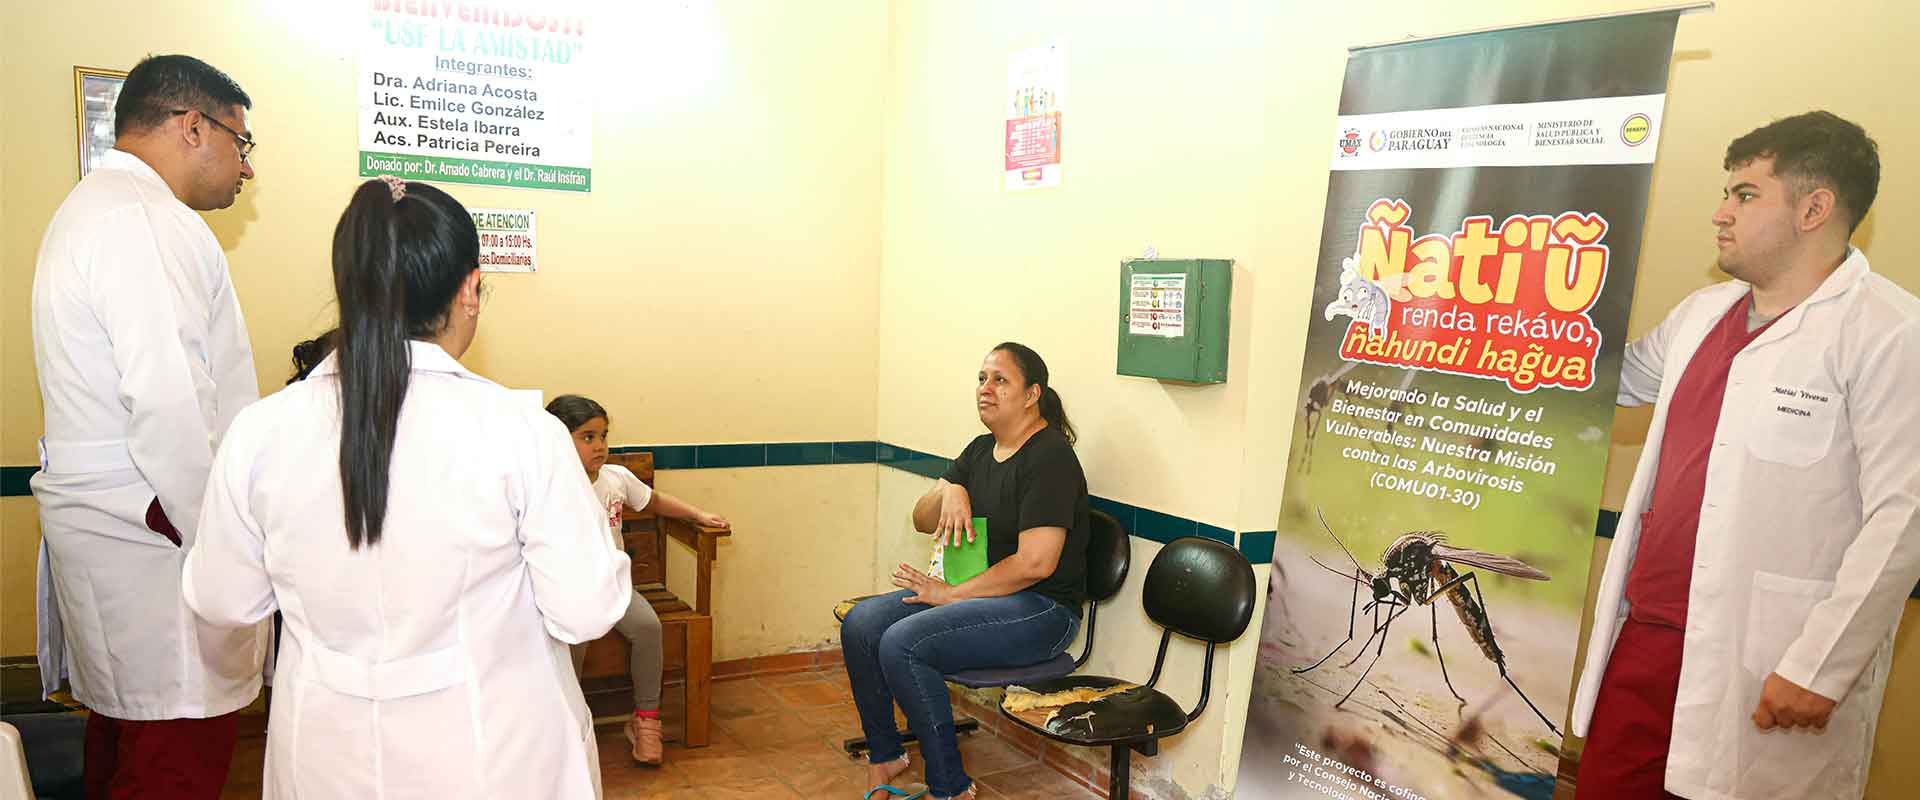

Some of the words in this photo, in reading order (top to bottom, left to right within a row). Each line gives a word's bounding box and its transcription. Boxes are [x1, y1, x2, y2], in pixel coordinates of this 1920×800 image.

[438, 26, 466, 53] LA
[435, 55, 532, 79] Integrantes:
[374, 72, 407, 88] Dra.
[412, 76, 477, 96] Adriana
[482, 83, 537, 102] Acosta
[374, 91, 404, 108] Lic.
[410, 95, 466, 113] Emilce
[471, 101, 545, 121] González
[373, 111, 412, 127] Aux.
[418, 115, 468, 132] Estela
[474, 120, 520, 136] Ibarra
[1389, 128, 1438, 140] GOBIERNO
[1489, 123, 1524, 131] NACIONAL
[1536, 129, 1560, 138] SALUD
[1537, 120, 1582, 129] MINISTERIO
[1583, 119, 1594, 127] DE
[373, 131, 411, 146] Acs.
[417, 134, 479, 152] Patricia
[484, 140, 540, 157] Pereira
[1388, 138, 1451, 151] PARAGUAY
[1535, 138, 1574, 147] BIENESTAR
[1576, 137, 1605, 145] SOCIAL
[366, 155, 402, 171] Donado
[404, 161, 423, 175] por:
[424, 160, 437, 174] Dr.
[439, 161, 469, 177] Amado
[471, 163, 505, 180] Cabrera
[507, 169, 513, 183] y
[514, 168, 522, 180] el
[524, 168, 536, 181] Dr.
[538, 169, 556, 183] Raúl
[472, 213, 484, 227] DE
[486, 213, 529, 229] ATENCION
[481, 233, 498, 247] 07:00
[500, 237, 503, 247] a
[505, 234, 521, 248] 15:00
[491, 251, 531, 266] Domiciliarias
[1402, 306, 1477, 332] renda
[1486, 310, 1593, 347] rekávo,
[1345, 325, 1471, 366] ñahundi
[1346, 380, 1427, 404] Mejorando
[1431, 392, 1450, 408] la
[1454, 395, 1506, 417] Salud
[1507, 406, 1521, 422] y
[1525, 406, 1544, 423] el
[1777, 405, 1811, 416] MEDICINA
[1331, 399, 1402, 423] Bienestar
[1404, 414, 1425, 427] en
[1429, 415, 1554, 449] Comunidades
[1325, 419, 1417, 449] Vulnerables:
[1420, 436, 1491, 462] Nuestra
[1495, 450, 1556, 475] Misión
[1342, 447, 1390, 466] contra
[1392, 454, 1417, 471] las
[1422, 459, 1524, 493] Arbovirosis
[1283, 754, 1301, 767] por
[1302, 763, 1313, 773] el
[1314, 767, 1357, 791] Consejo
[1288, 771, 1295, 781] y
[1322, 757, 1372, 783] proyecto
[1374, 778, 1387, 789] es
